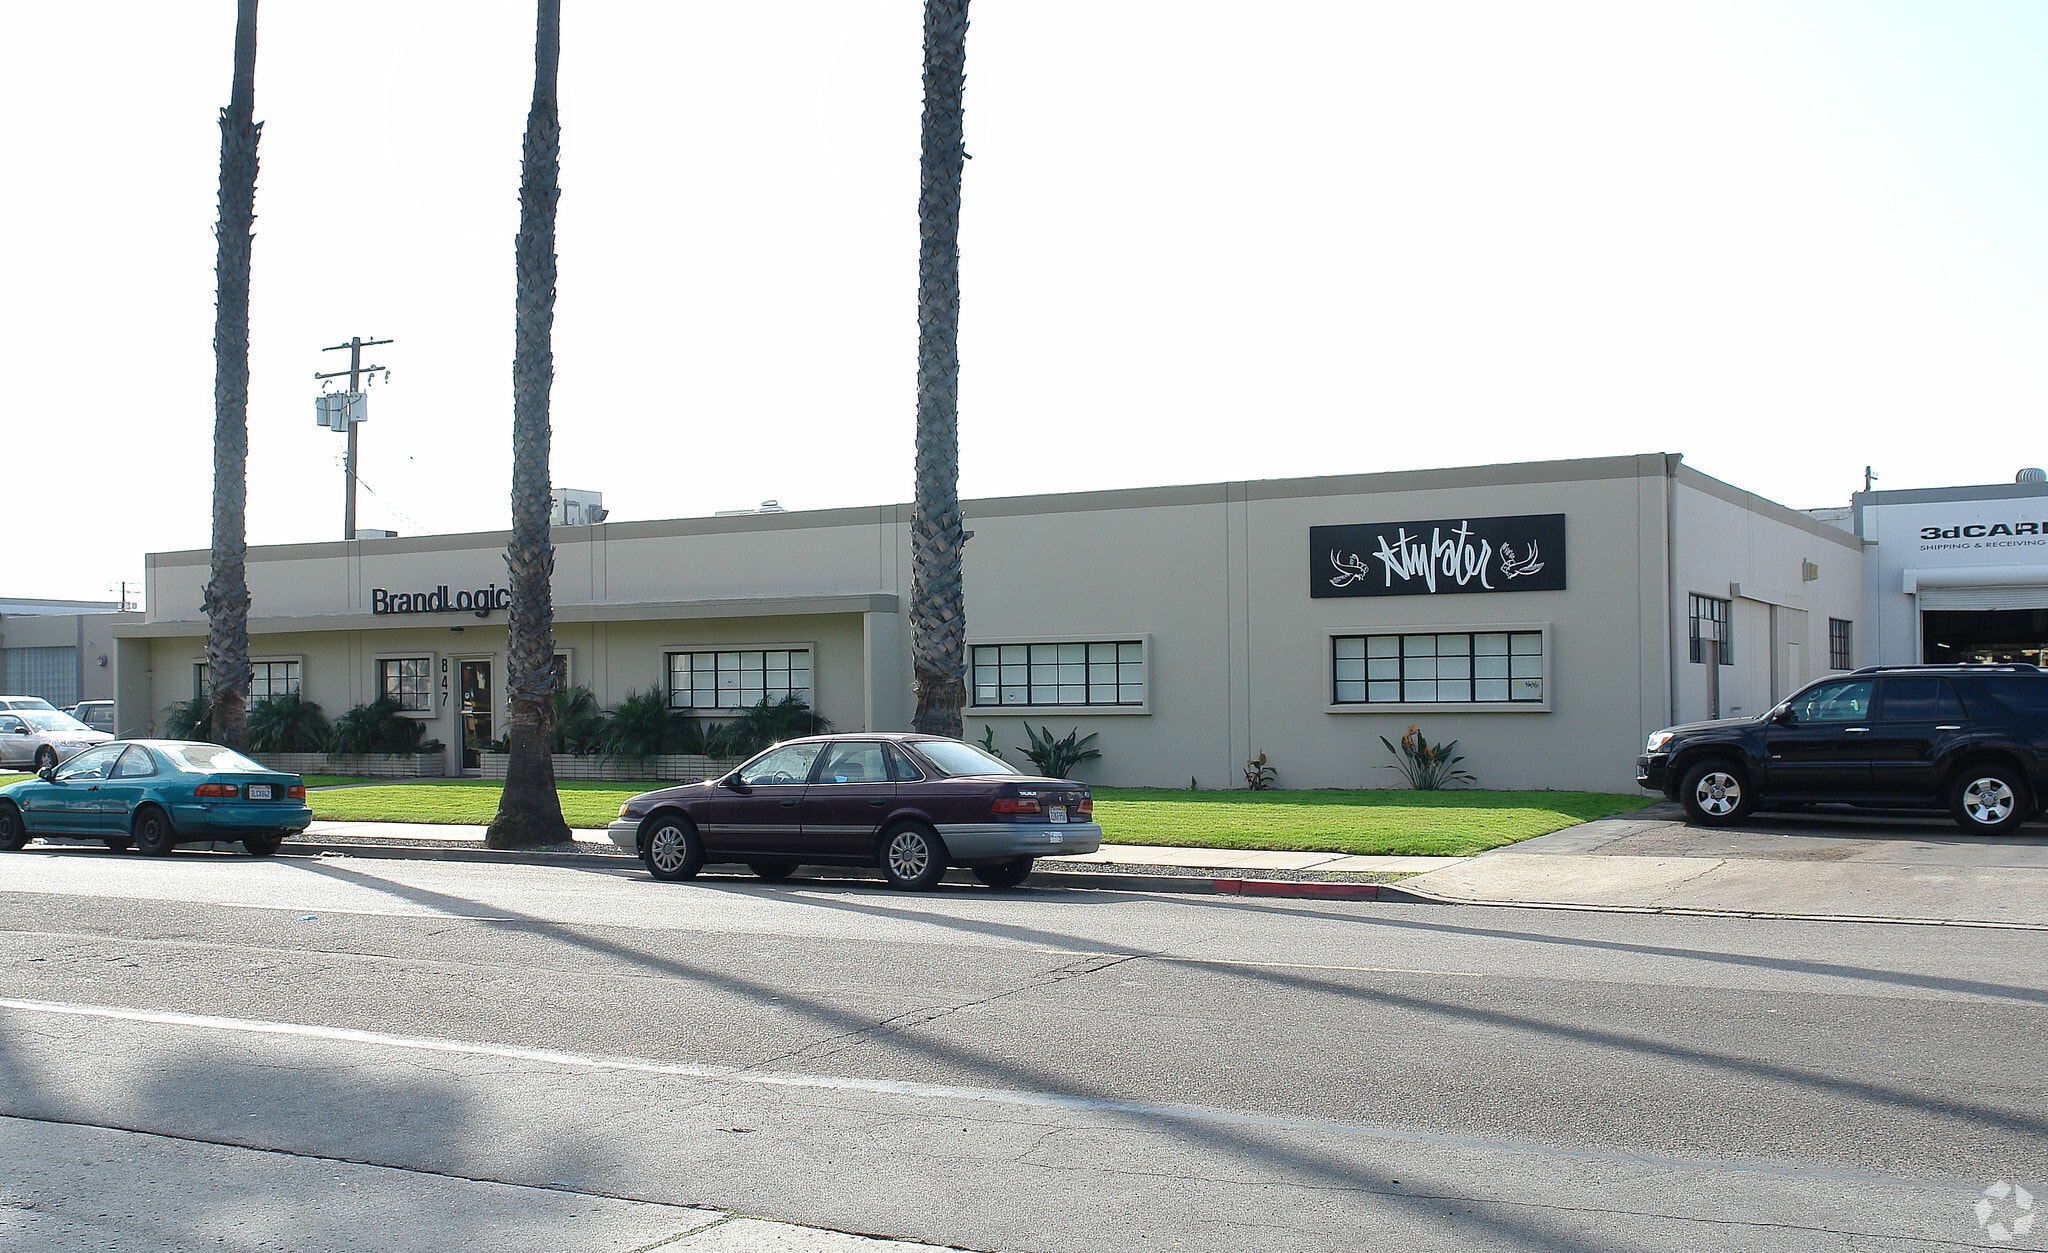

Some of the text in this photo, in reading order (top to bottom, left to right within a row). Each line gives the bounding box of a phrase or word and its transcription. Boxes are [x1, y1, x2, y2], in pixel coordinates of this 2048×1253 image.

[1920, 543, 1970, 551] SHIPPING
[1986, 539, 2046, 548] RECEIVING
[372, 583, 510, 617] BrandLogic
[441, 658, 449, 707] 847
